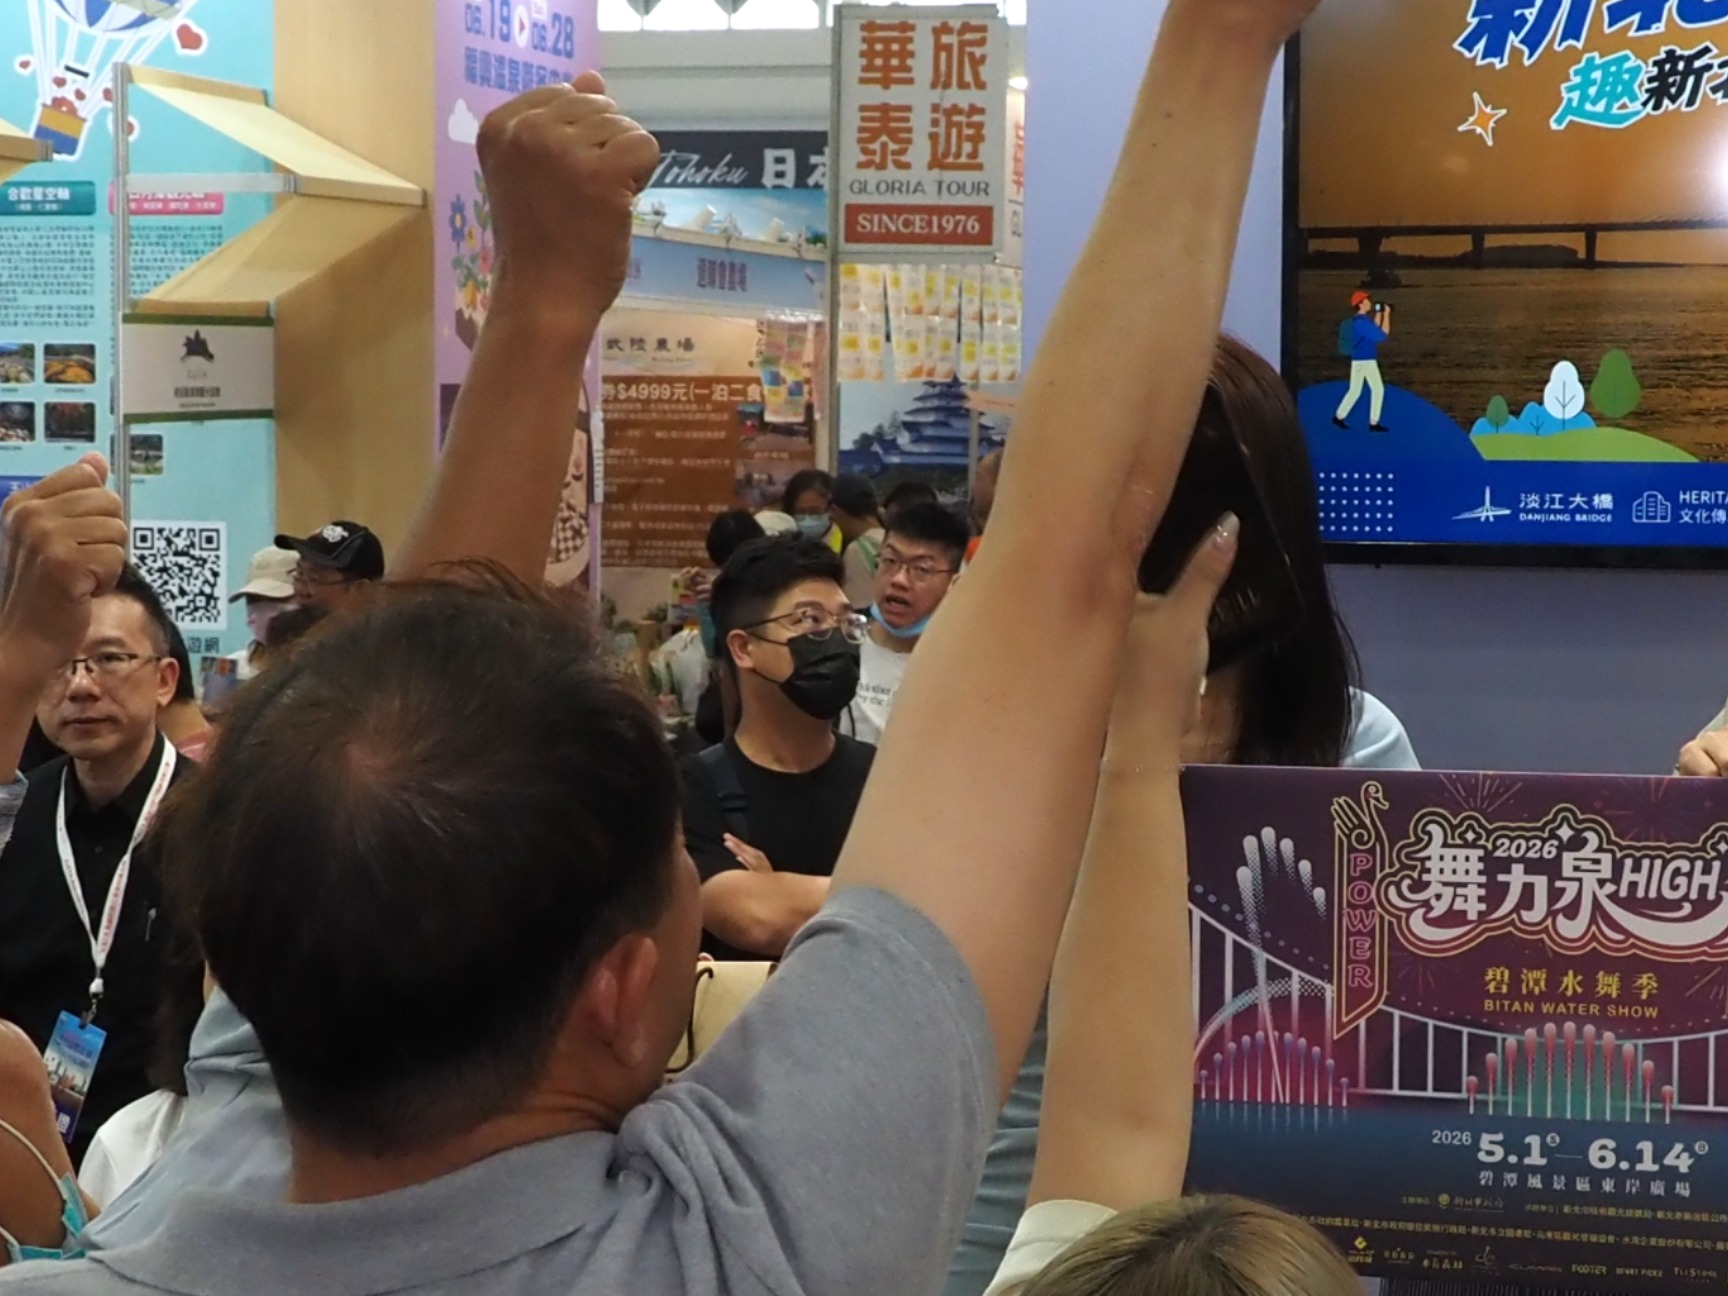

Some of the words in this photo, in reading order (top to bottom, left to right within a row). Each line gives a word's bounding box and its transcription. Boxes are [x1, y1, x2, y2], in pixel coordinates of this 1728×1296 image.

[849, 179, 927, 197] GLORIA
[933, 179, 990, 198] TOUR
[1519, 491, 1614, 510] 淡江大橋
[1519, 512, 1571, 524] DANJIANG
[1575, 512, 1614, 524] BRIDGE
[1493, 837, 1560, 861] 2026
[1618, 857, 1722, 902] HIGH
[1345, 852, 1378, 988] POWER
[1484, 968, 1660, 999] 碧潭水舞季
[1483, 998, 1535, 1016] BITAN
[1541, 1001, 1602, 1018] WATER
[1606, 1002, 1660, 1020] SHOW
[1431, 1129, 1472, 1146] 2026
[1478, 1169, 1692, 1198] 碧潭風景區東岸廣場
